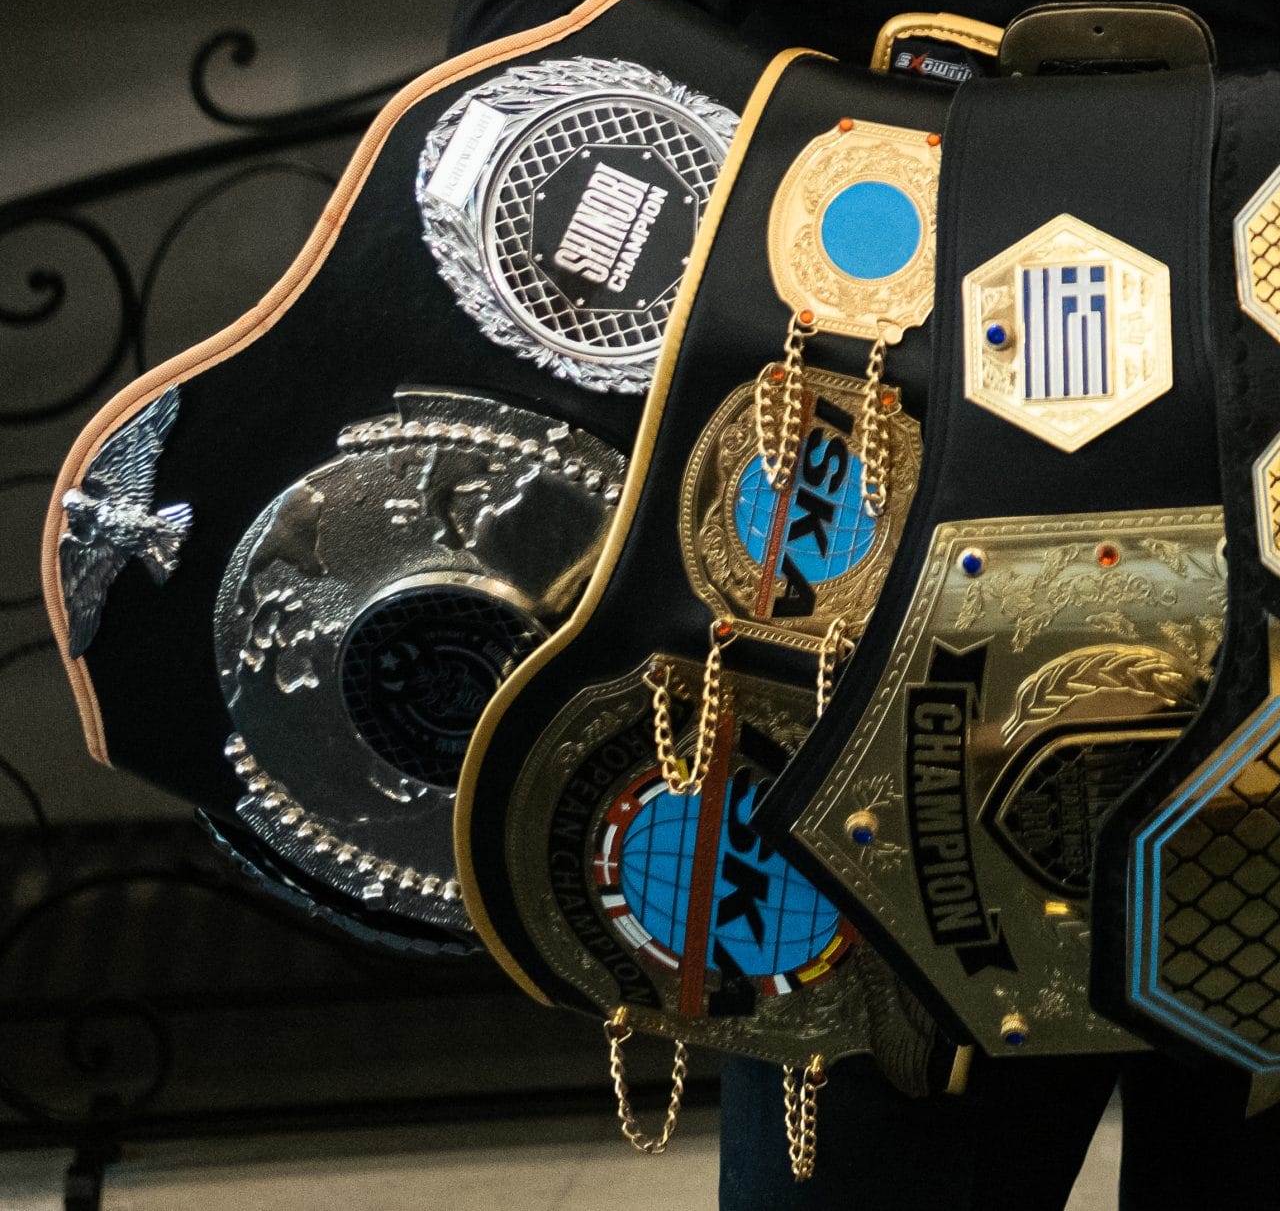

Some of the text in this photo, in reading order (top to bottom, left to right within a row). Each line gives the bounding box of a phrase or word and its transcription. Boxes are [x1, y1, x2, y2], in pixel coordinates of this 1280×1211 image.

[554, 161, 650, 283] SHINOBI
[608, 185, 669, 293] CHAMPION
[771, 399, 854, 618] ISKA
[912, 701, 981, 936] CHAMPION
